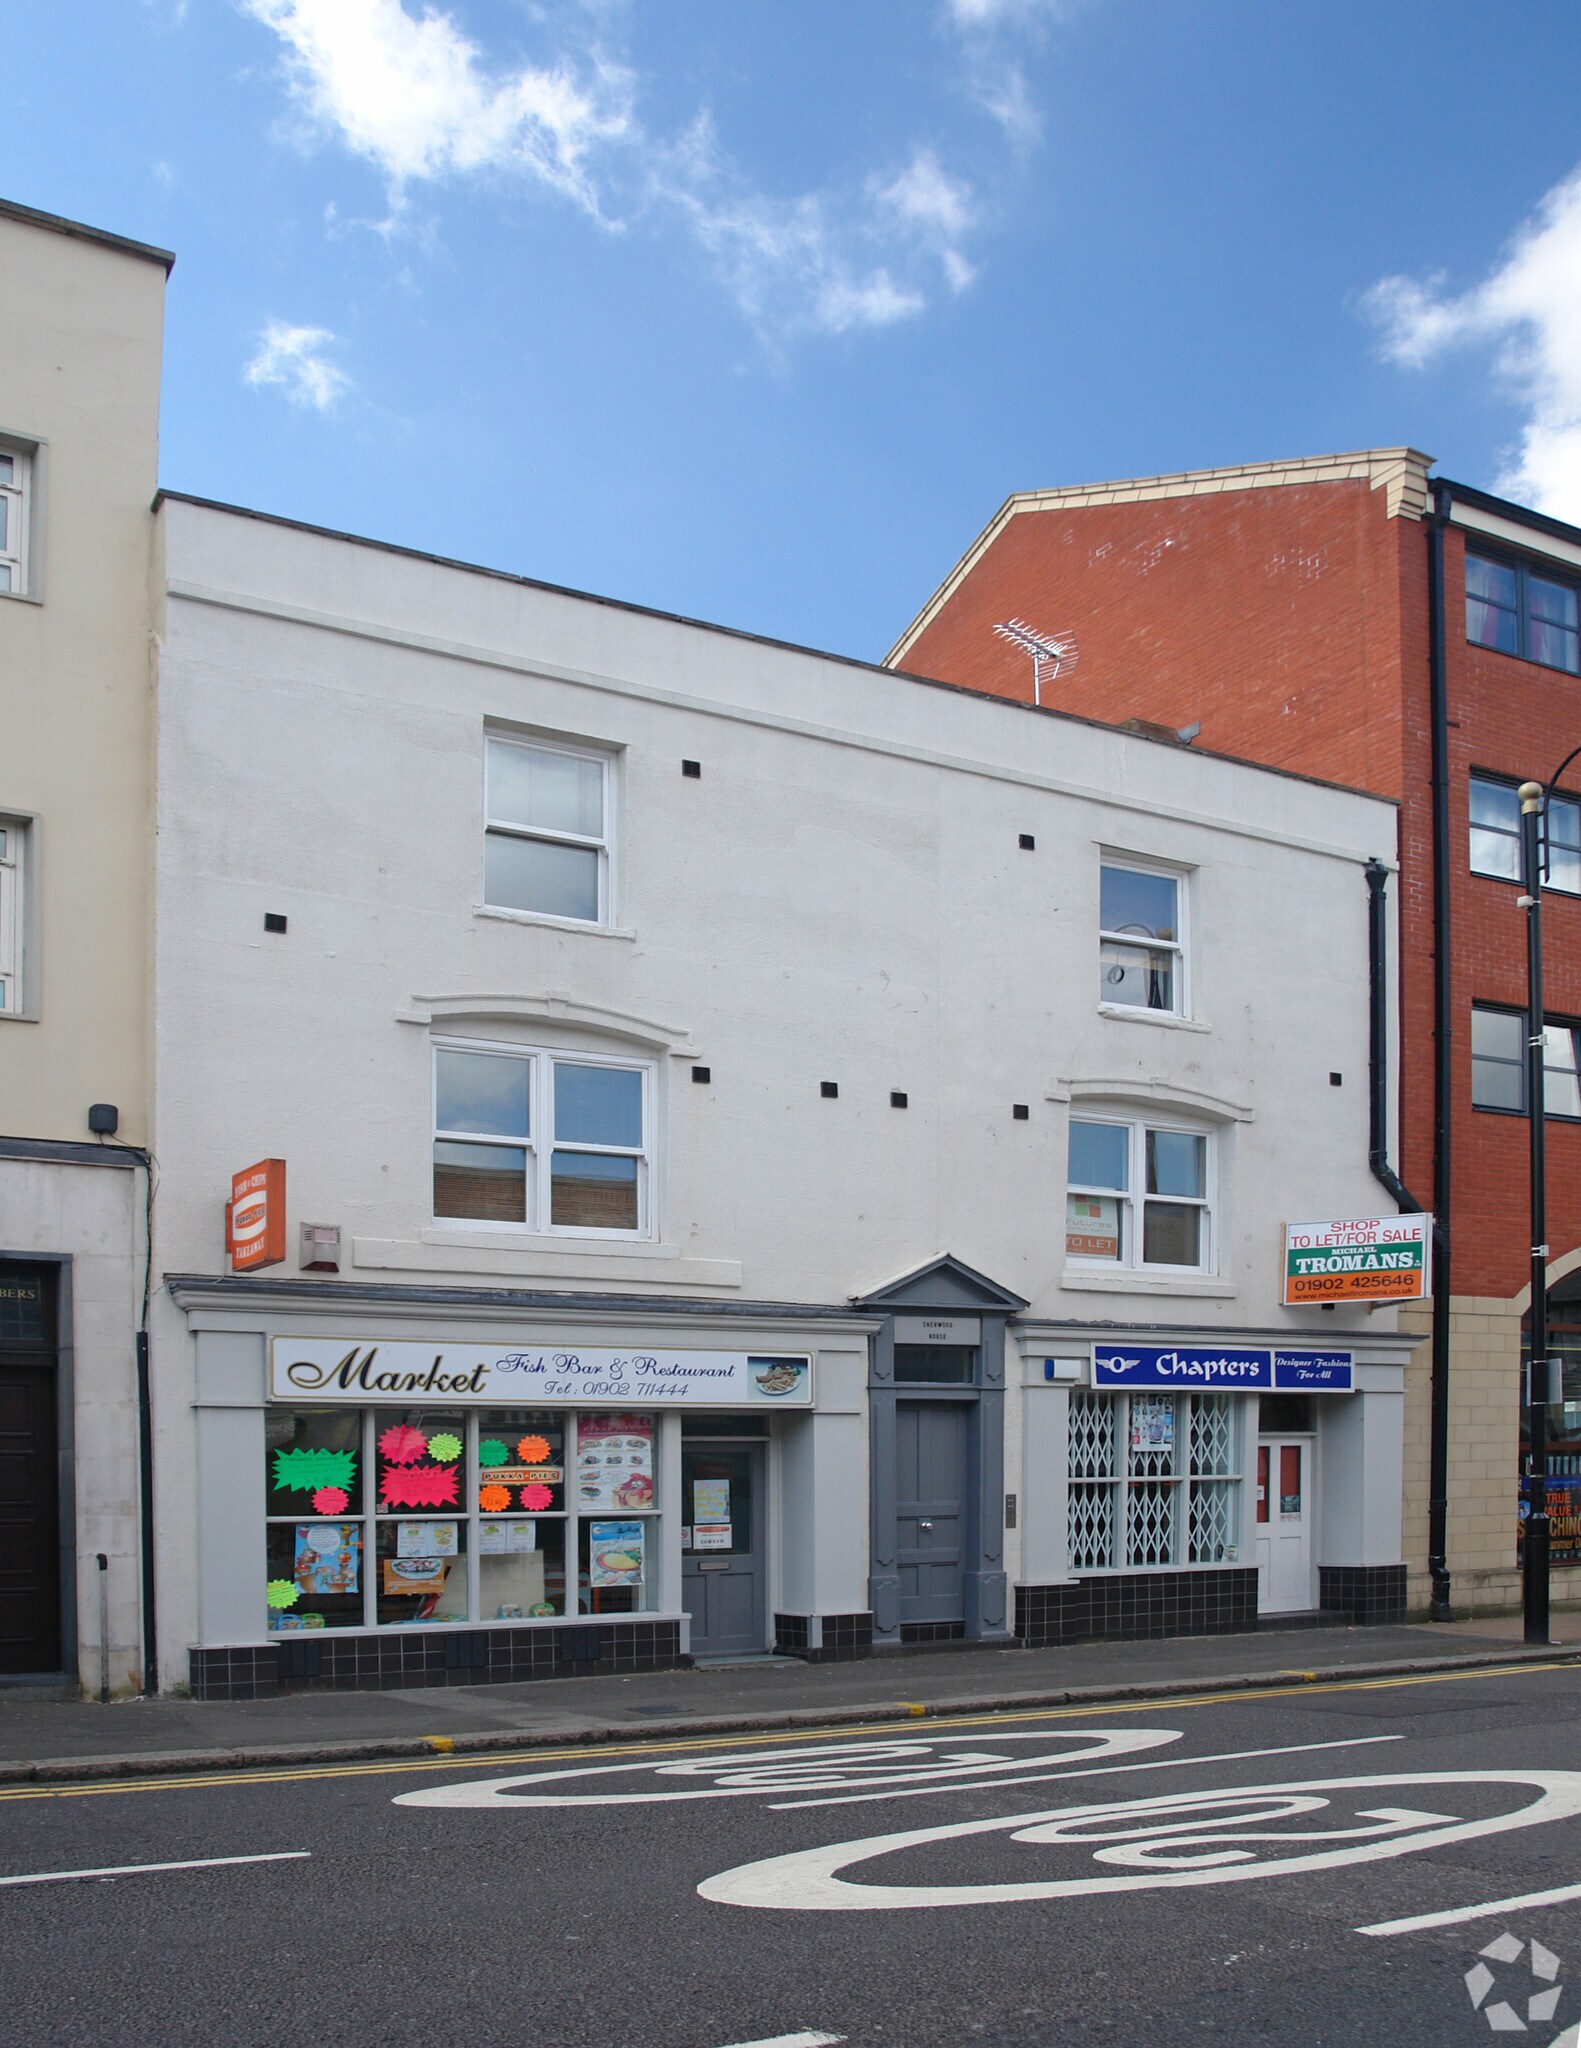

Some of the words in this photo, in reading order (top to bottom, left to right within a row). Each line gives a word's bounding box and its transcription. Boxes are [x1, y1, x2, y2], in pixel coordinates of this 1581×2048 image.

[1330, 1220, 1380, 1233] SHOP
[1088, 1238, 1113, 1249] LET
[1291, 1235, 1311, 1248] TO
[1315, 1231, 1377, 1247] LET/FOR
[1382, 1228, 1422, 1243] SALE
[235, 1236, 265, 1259] TAKEAWAY
[1331, 1246, 1377, 1256] MICHAEL
[1296, 1252, 1414, 1274] TROMANS
[1295, 1278, 1344, 1292] 01902
[1350, 1274, 1414, 1288] 425646
[1294, 1287, 1414, 1300] www.michaeltromans.co.uk
[287, 1346, 491, 1394] Market
[495, 1353, 548, 1374] Fish
[552, 1353, 604, 1375] Bar
[609, 1357, 628, 1381] &
[630, 1356, 736, 1378] Restaurant
[1155, 1352, 1261, 1381] Chapters
[1275, 1357, 1313, 1368] Designer
[1296, 1369, 1315, 1380] For
[1315, 1370, 1332, 1379] All
[582, 1381, 630, 1396] 01902
[636, 1382, 689, 1397] 711444
[1545, 1492, 1571, 1504] TRUE
